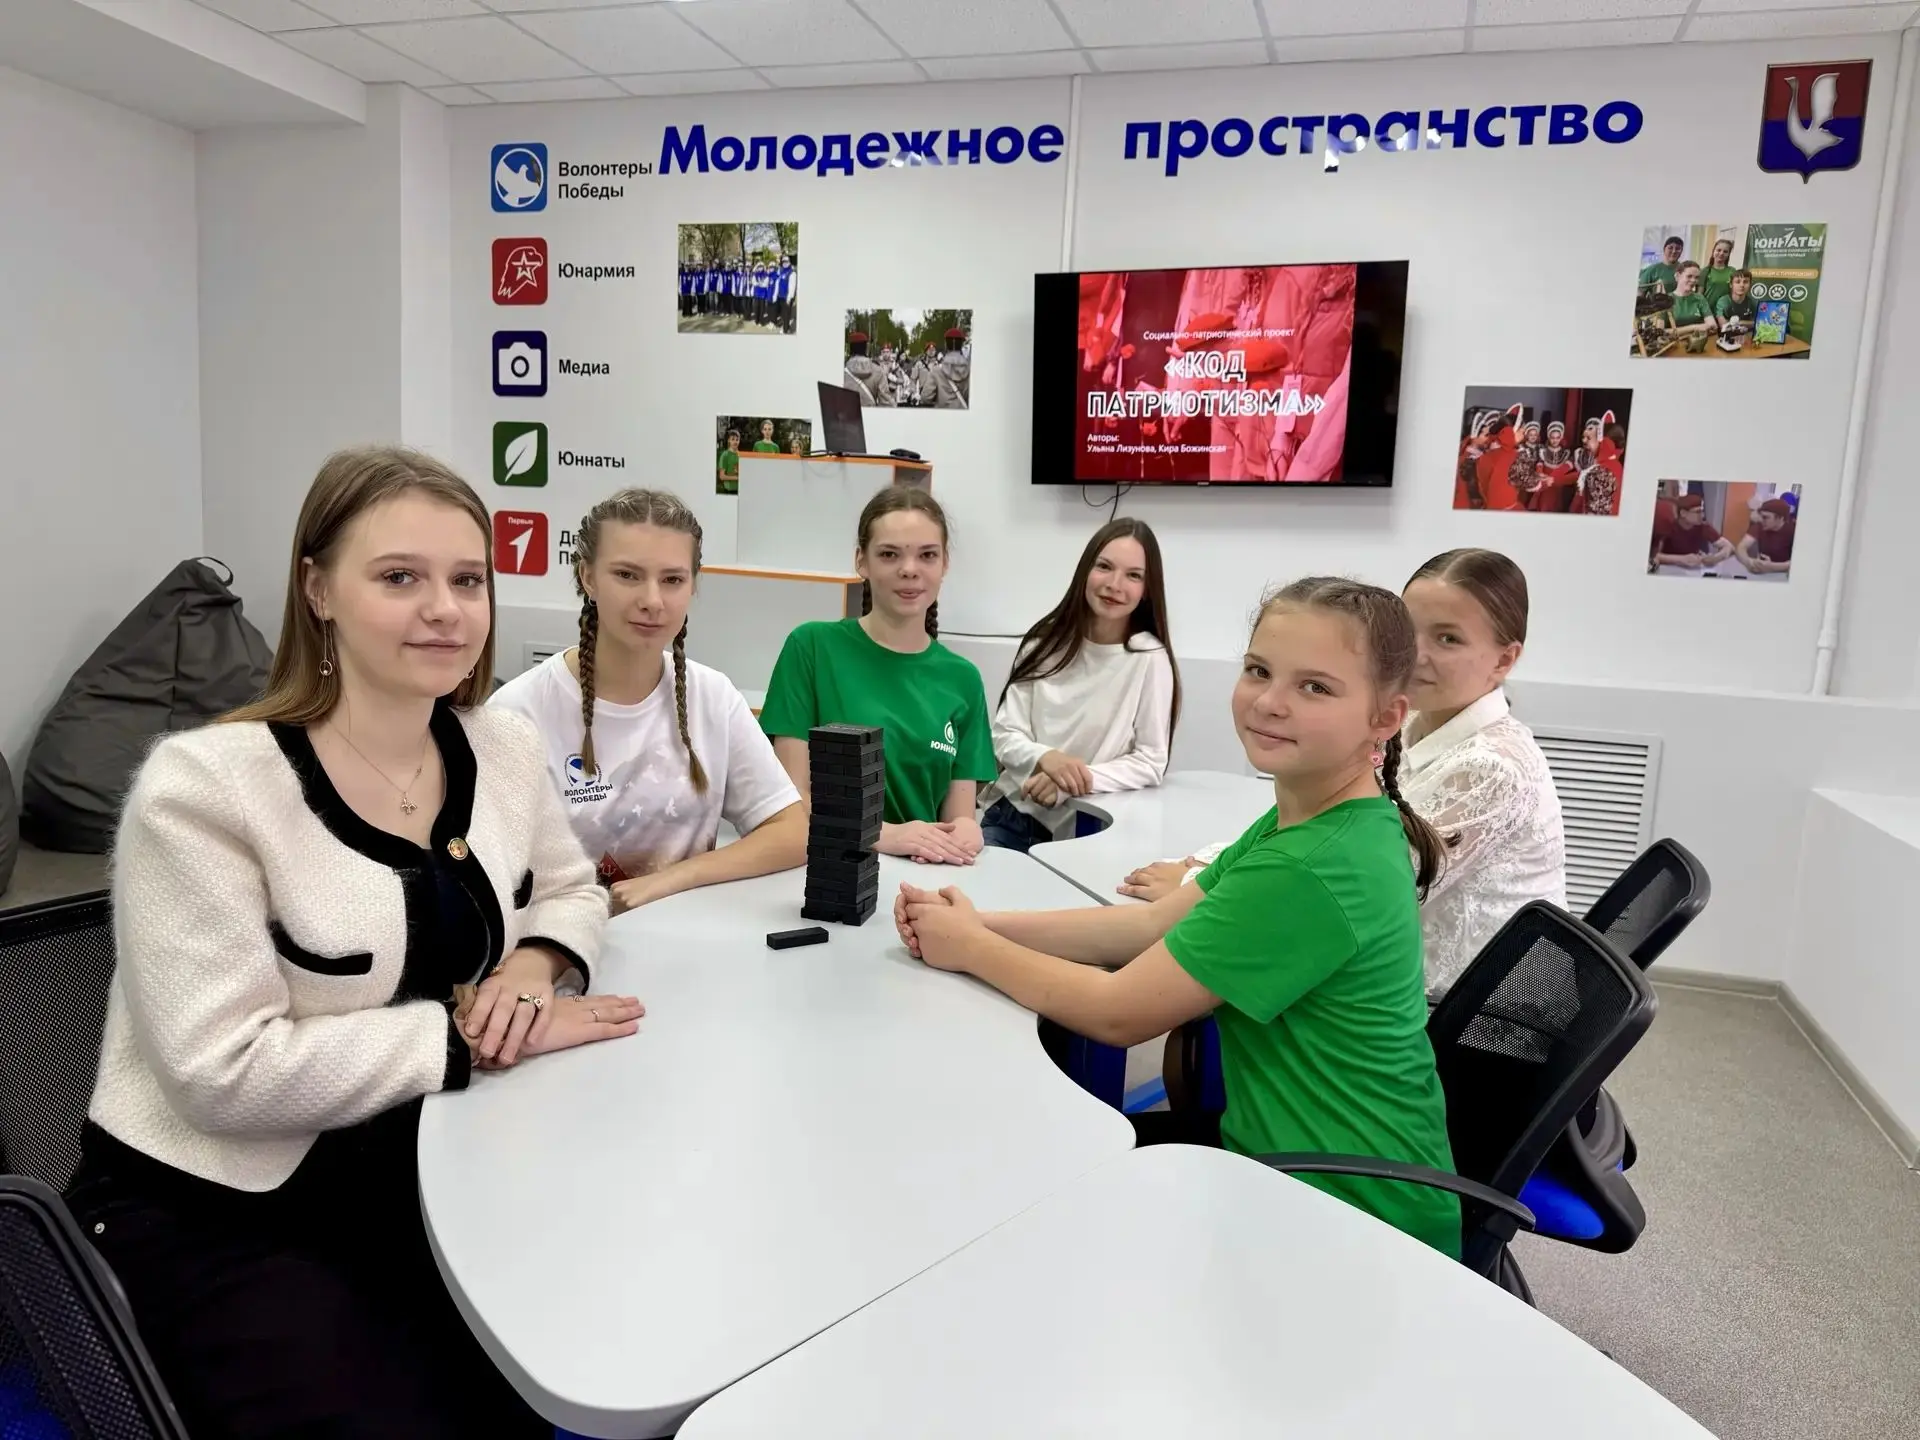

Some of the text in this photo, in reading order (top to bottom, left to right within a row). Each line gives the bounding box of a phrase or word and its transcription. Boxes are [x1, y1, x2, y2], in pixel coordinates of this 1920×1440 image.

[658, 100, 1644, 178] Молодежное пространство
[558, 161, 652, 179] Волонтеры
[558, 182, 624, 200] Победы
[558, 262, 635, 281] Юнармия
[1263, 327, 1295, 338] проект
[558, 359, 610, 376] Медиа
[1164, 350, 1247, 382] «КОД
[1087, 389, 1326, 418] ПАТРИОТИЗМА»
[1087, 433, 1120, 443] Авторы:
[1087, 444, 1115, 453] Ульяна
[1158, 443, 1179, 454] Кира
[558, 451, 625, 468] Юннаты
[508, 516, 534, 526] Первые
[571, 793, 608, 804] ПОБЕДЫ
